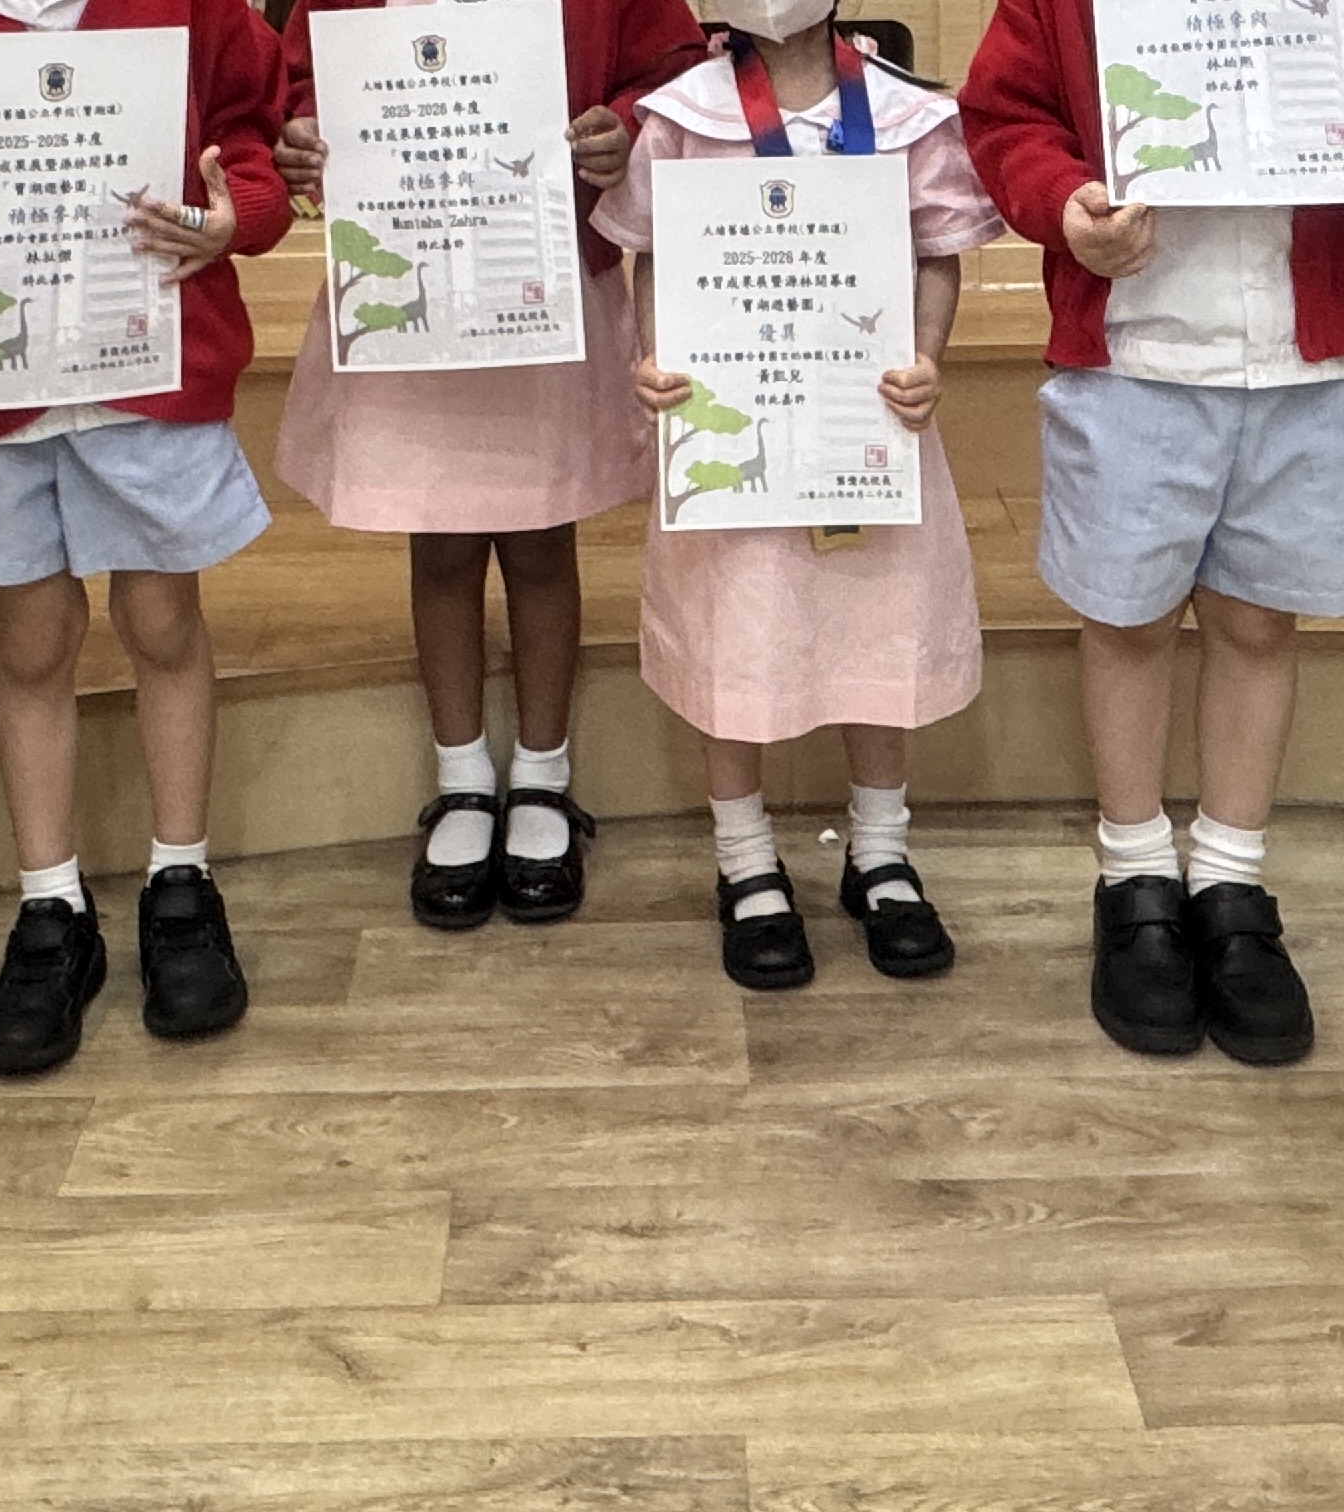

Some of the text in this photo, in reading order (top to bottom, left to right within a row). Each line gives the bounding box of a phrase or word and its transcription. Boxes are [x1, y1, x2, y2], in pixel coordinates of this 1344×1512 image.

[453, 100, 480, 116] 年度
[73, 132, 102, 147] 年度
[450, 214, 488, 227] Zahra
[799, 250, 828, 265] 年度
